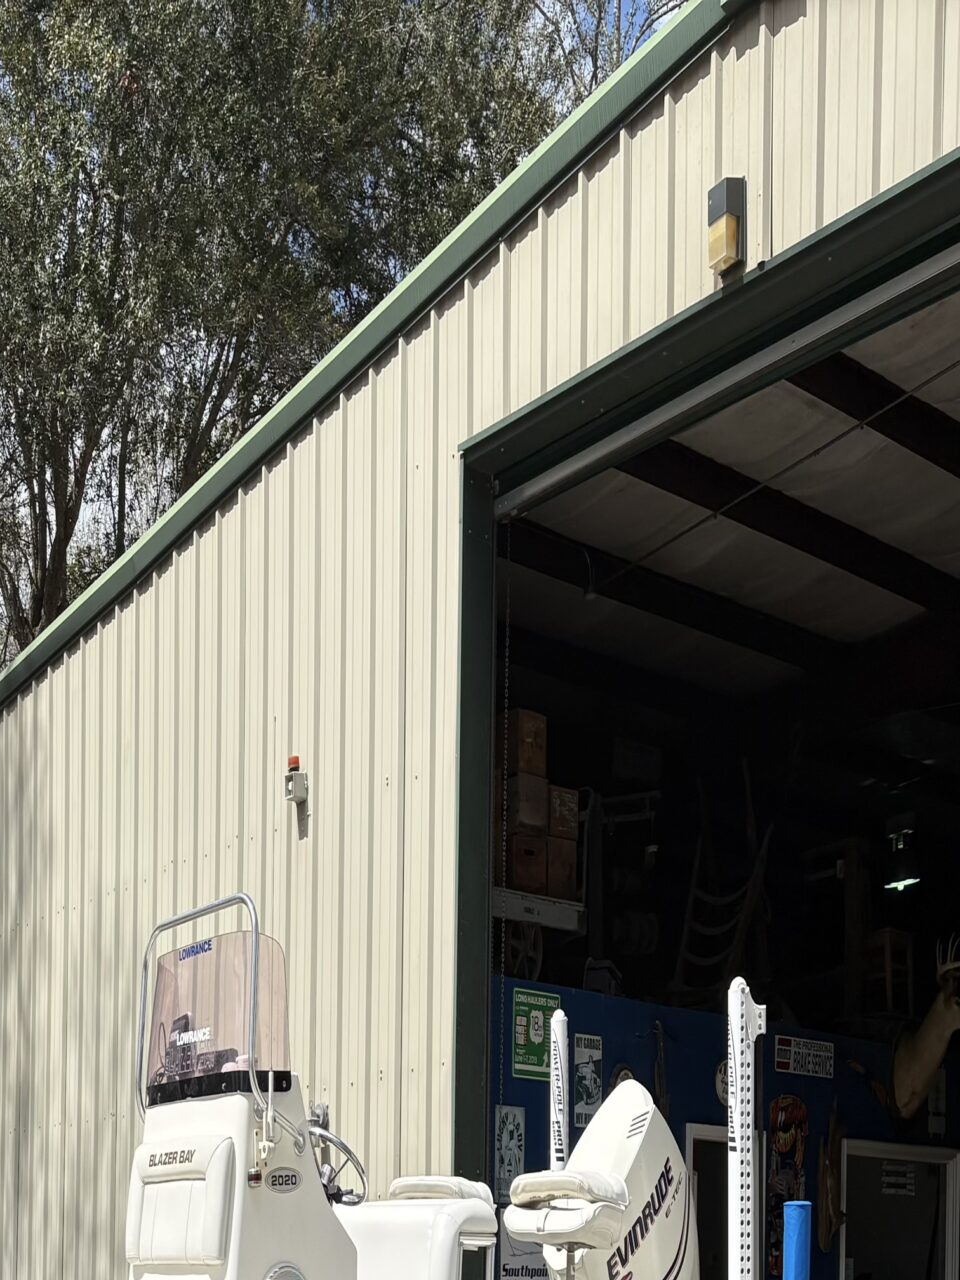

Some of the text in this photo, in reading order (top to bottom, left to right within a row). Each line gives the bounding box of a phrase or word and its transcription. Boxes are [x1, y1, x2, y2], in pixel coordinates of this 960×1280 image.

[178, 939, 213, 962] LOWRANCE
[515, 993, 559, 1008] LONG HAULERS ONLY
[176, 1027, 211, 1047] LOWRANCE
[793, 1039, 801, 1048] THE
[793, 1050, 833, 1077] BRAKE SERVICE
[149, 1149, 196, 1168] BLAZER BAY
[271, 1174, 297, 1187] 2020
